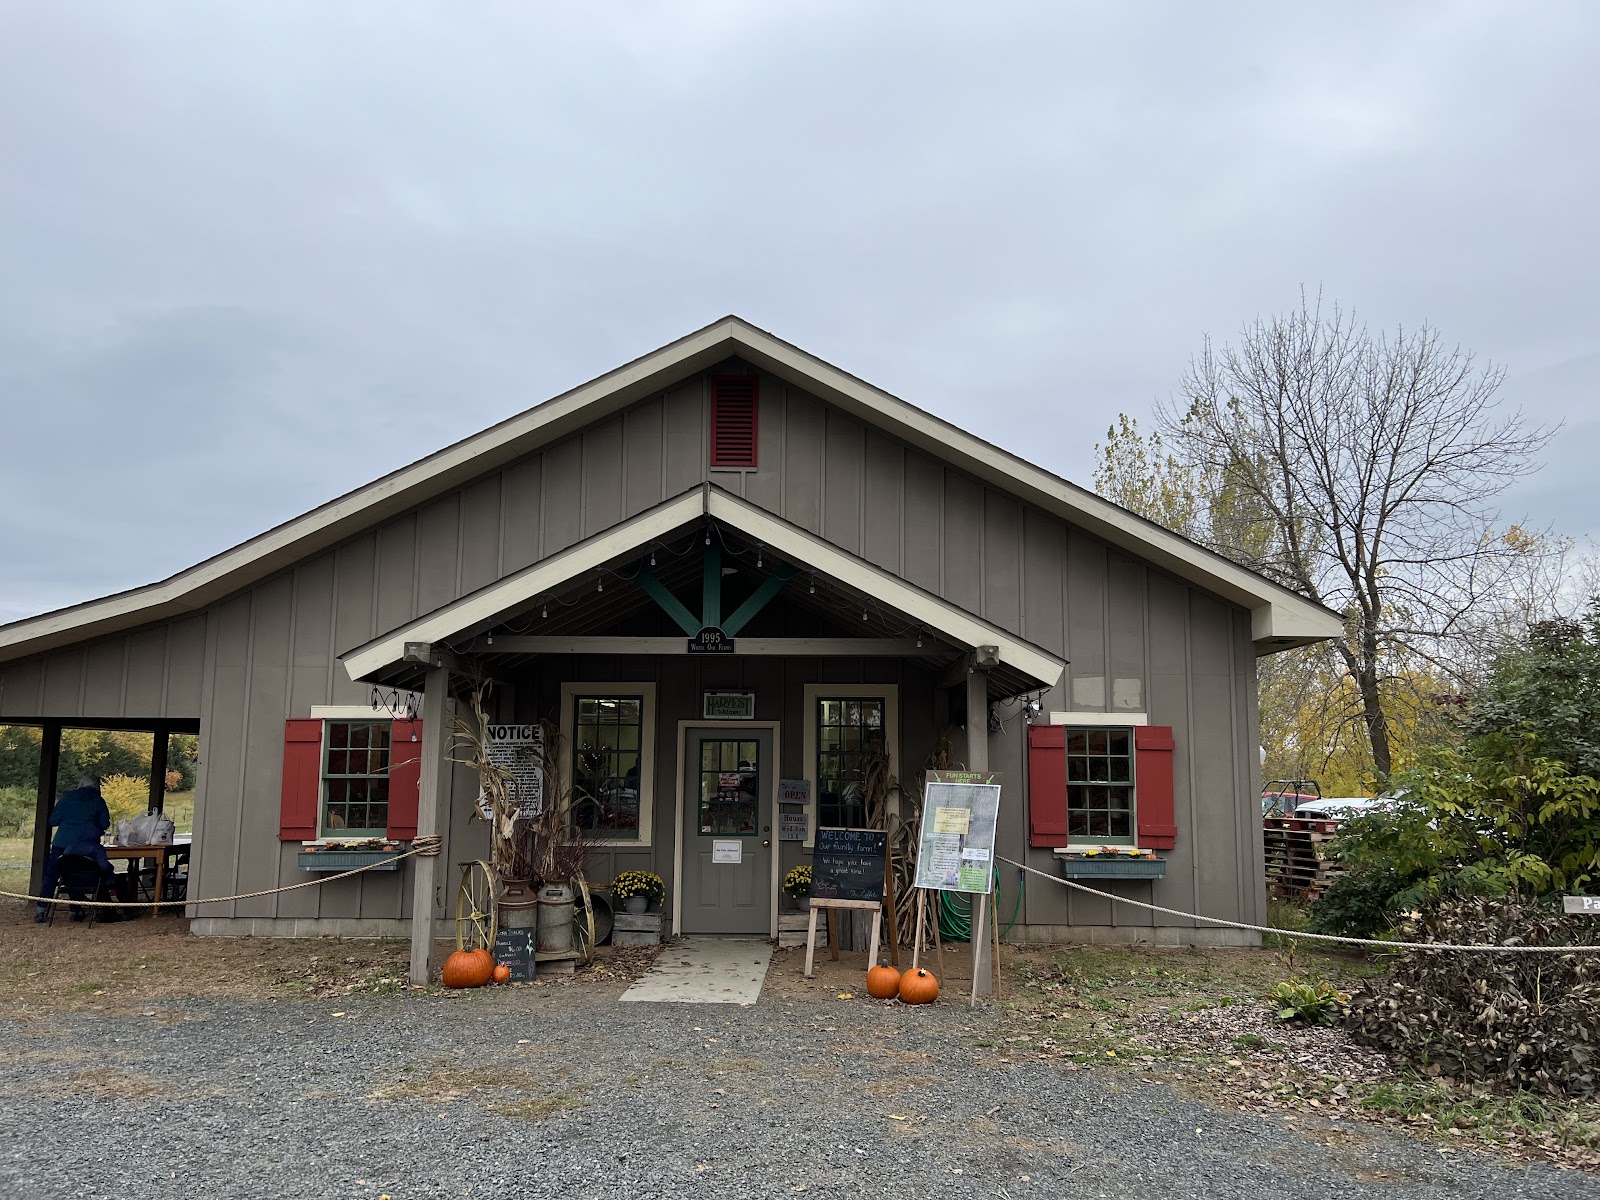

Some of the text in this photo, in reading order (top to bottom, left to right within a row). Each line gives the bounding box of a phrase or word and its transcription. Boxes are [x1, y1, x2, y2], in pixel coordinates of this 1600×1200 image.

[701, 632, 721, 643] 1995
[707, 697, 751, 716] HARVEST
[487, 725, 540, 740] NOTICE
[958, 772, 982, 780] STARTS
[784, 790, 807, 800] OPEN
[783, 814, 803, 822] Hours
[820, 830, 875, 842] WELCOME TO
[818, 842, 831, 850] Our
[832, 841, 853, 853] family
[822, 856, 872, 868] We hope you have
[835, 868, 848, 876] great
